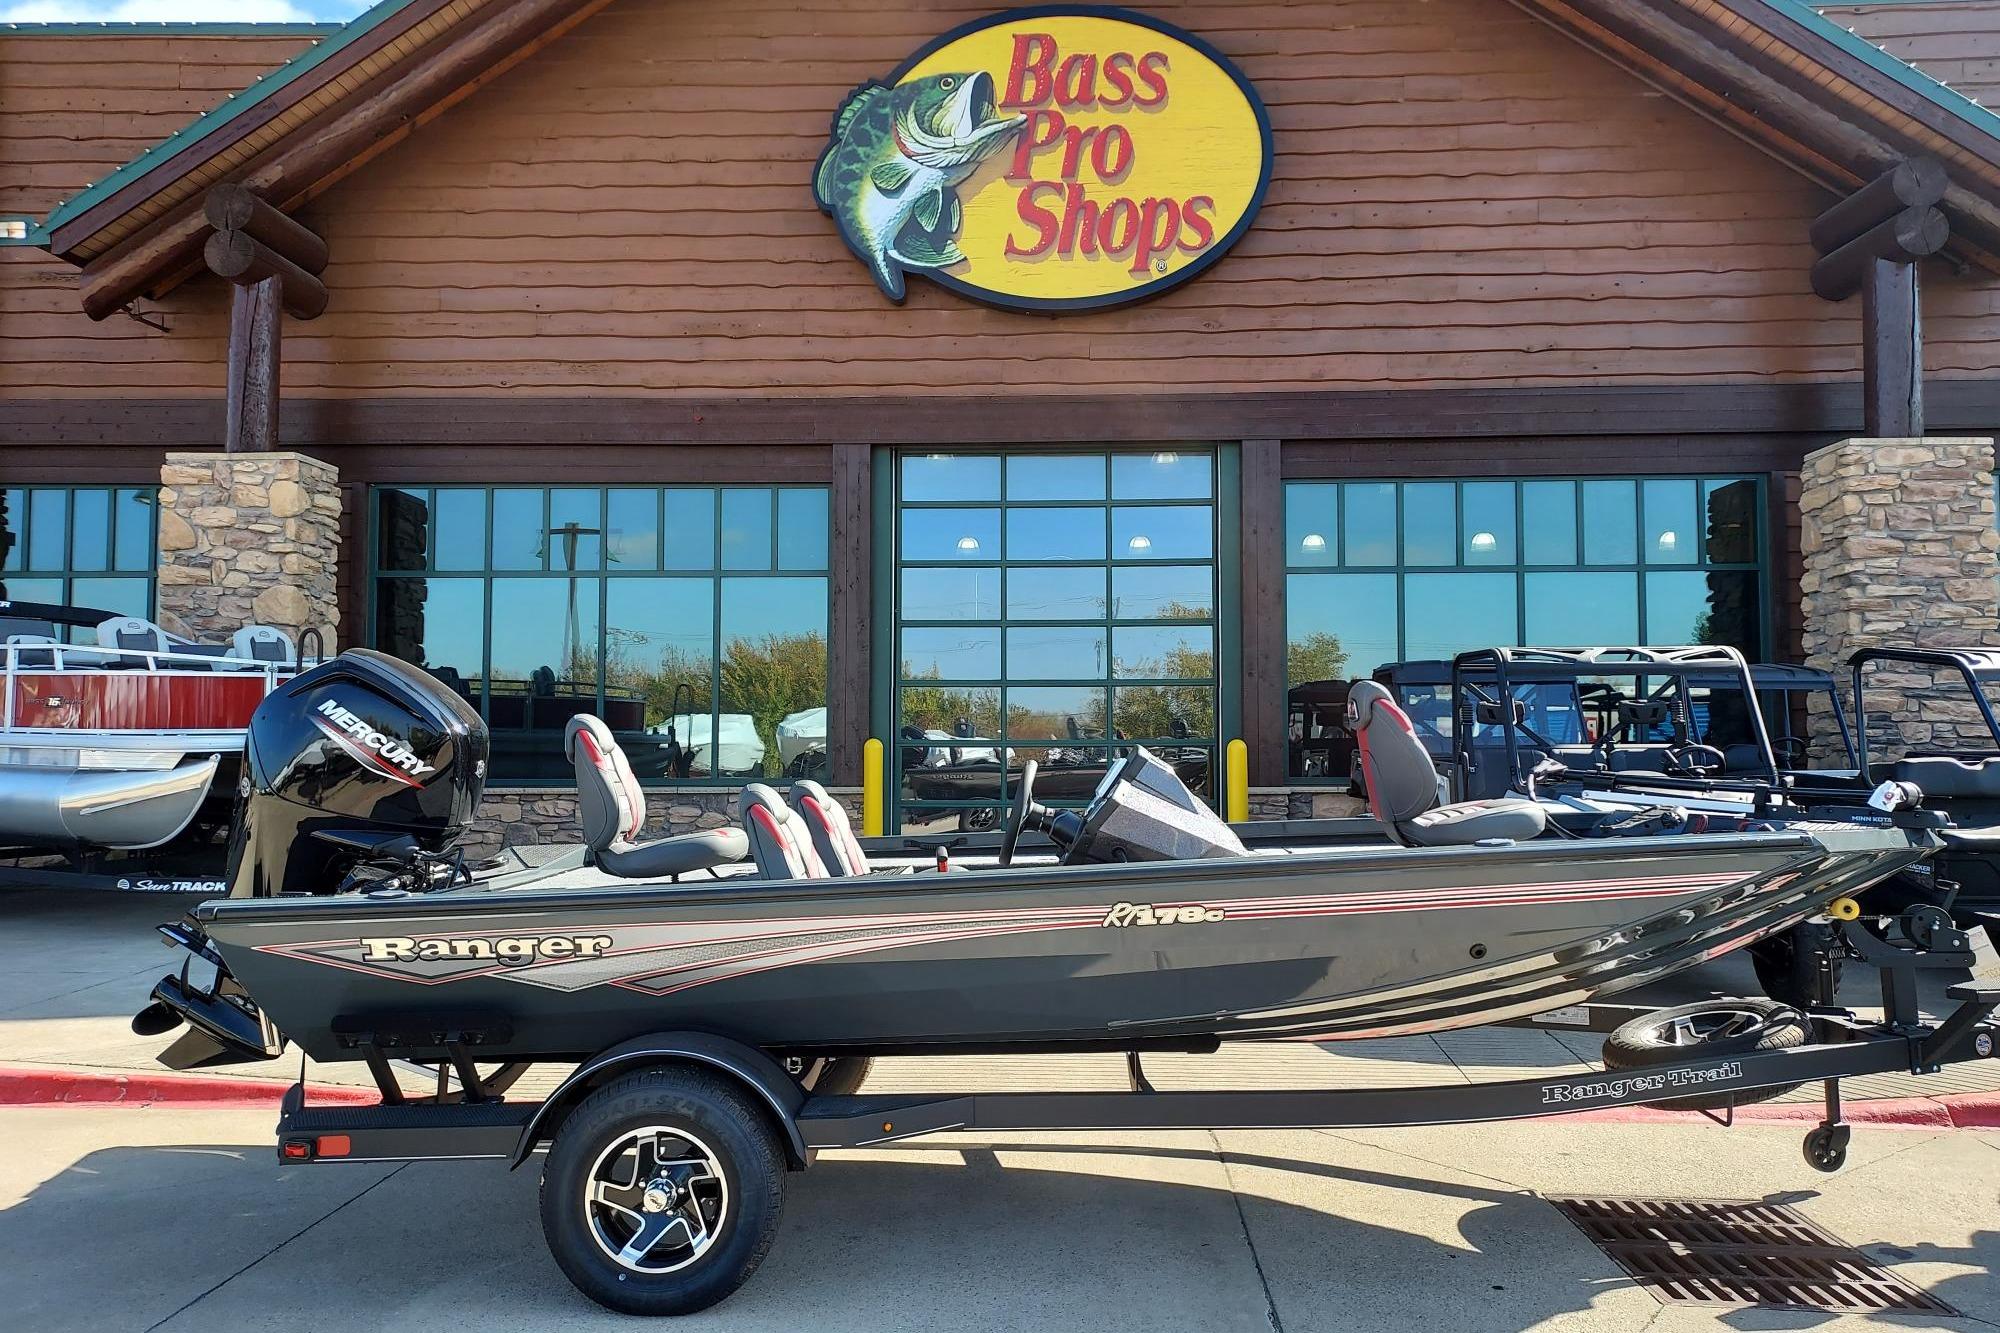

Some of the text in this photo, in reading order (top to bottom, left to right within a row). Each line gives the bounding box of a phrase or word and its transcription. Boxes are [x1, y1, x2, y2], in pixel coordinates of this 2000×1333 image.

[999, 32, 1170, 109] Bass
[1004, 109, 1136, 183] Pro
[1004, 181, 1215, 278] Shops
[317, 699, 436, 776] MERCURY
[360, 936, 614, 967] Ranger
[1542, 1062, 1743, 1104] Ranger Trail
